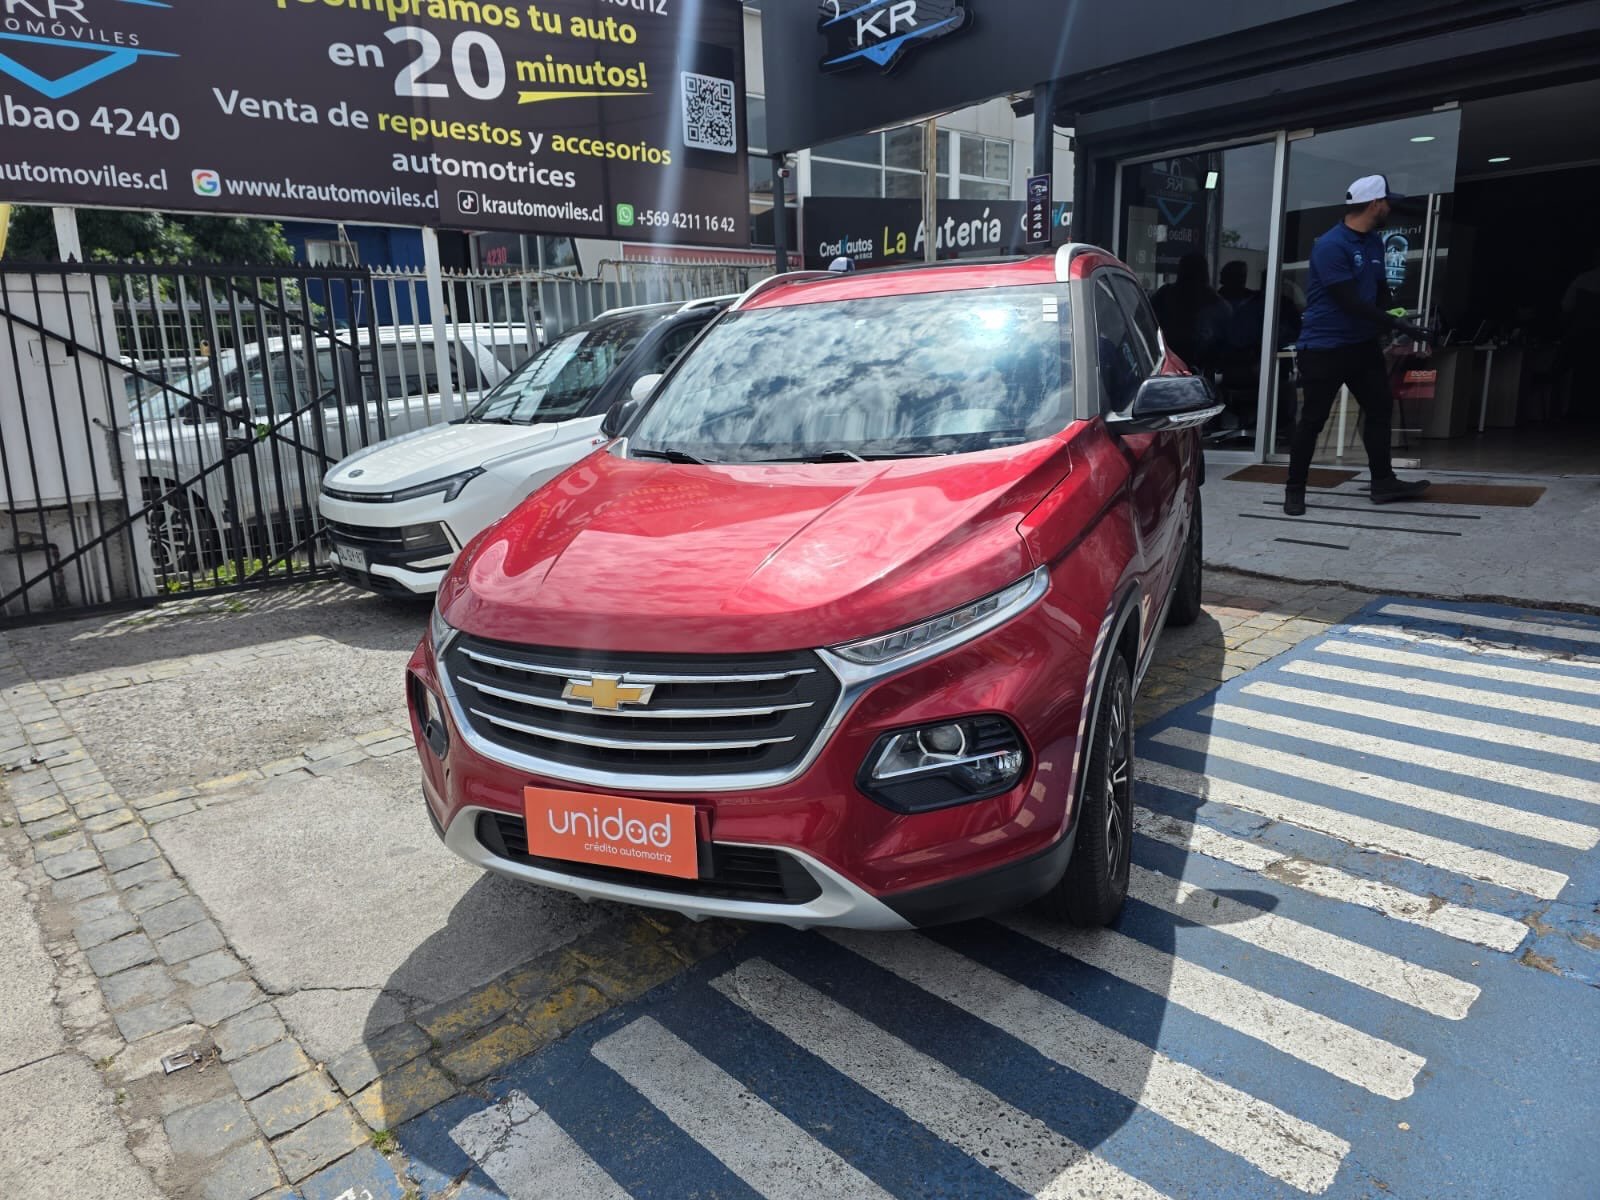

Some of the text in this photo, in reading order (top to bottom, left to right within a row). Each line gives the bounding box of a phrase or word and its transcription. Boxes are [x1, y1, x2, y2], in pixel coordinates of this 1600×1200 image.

[527, 5, 562, 34] tu
[570, 17, 637, 44] auto
[856, 0, 918, 47] KR
[328, 26, 648, 100] en 20 minutos!
[90, 106, 181, 141] 4240
[212, 87, 672, 165] Venta de repuestos y accesorios
[392, 152, 576, 188] automotrices
[226, 178, 439, 208] www.krautomoviles.cl
[482, 193, 604, 222] krautomoviles.cl
[637, 210, 669, 227] +569
[672, 212, 700, 230] 4211
[883, 225, 907, 257] La
[548, 807, 671, 848] unidad
[584, 841, 673, 863] crédito automotriz
